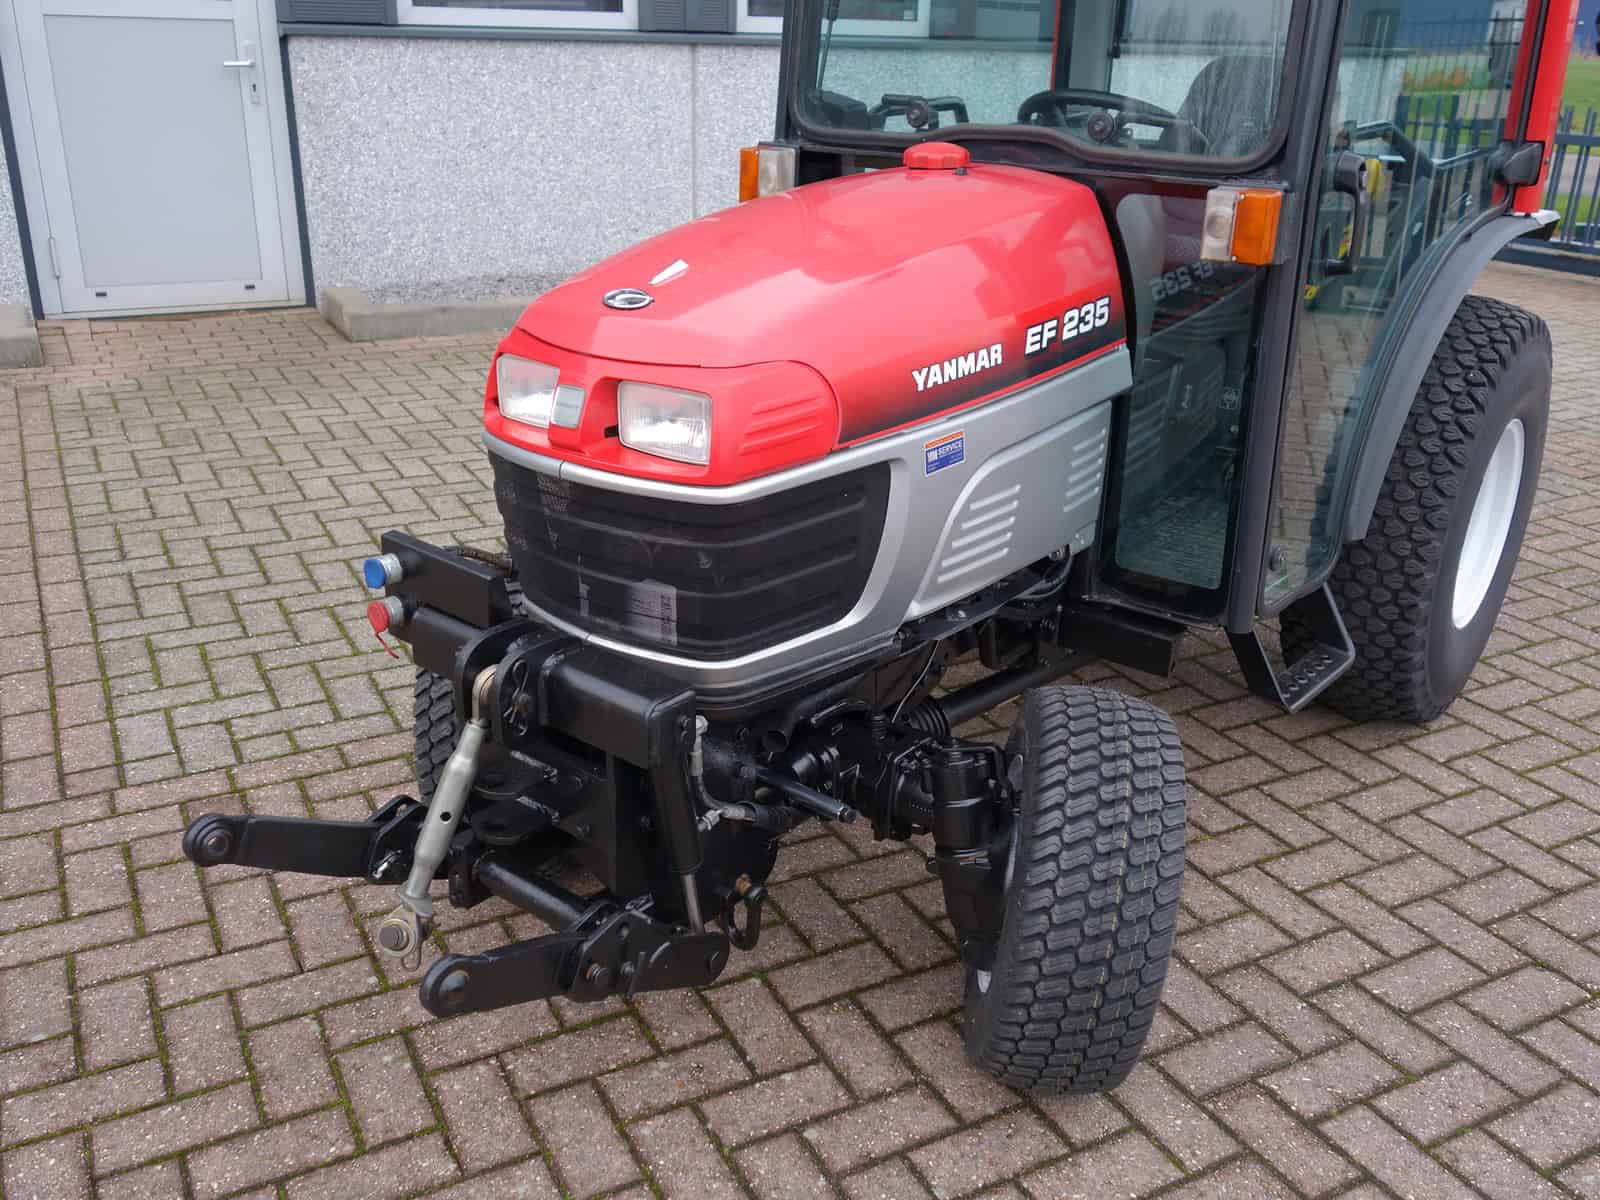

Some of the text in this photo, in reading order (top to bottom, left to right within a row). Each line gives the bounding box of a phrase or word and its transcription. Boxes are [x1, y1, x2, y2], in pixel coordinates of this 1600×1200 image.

[912, 297, 1110, 392] YANMAR EF 235
